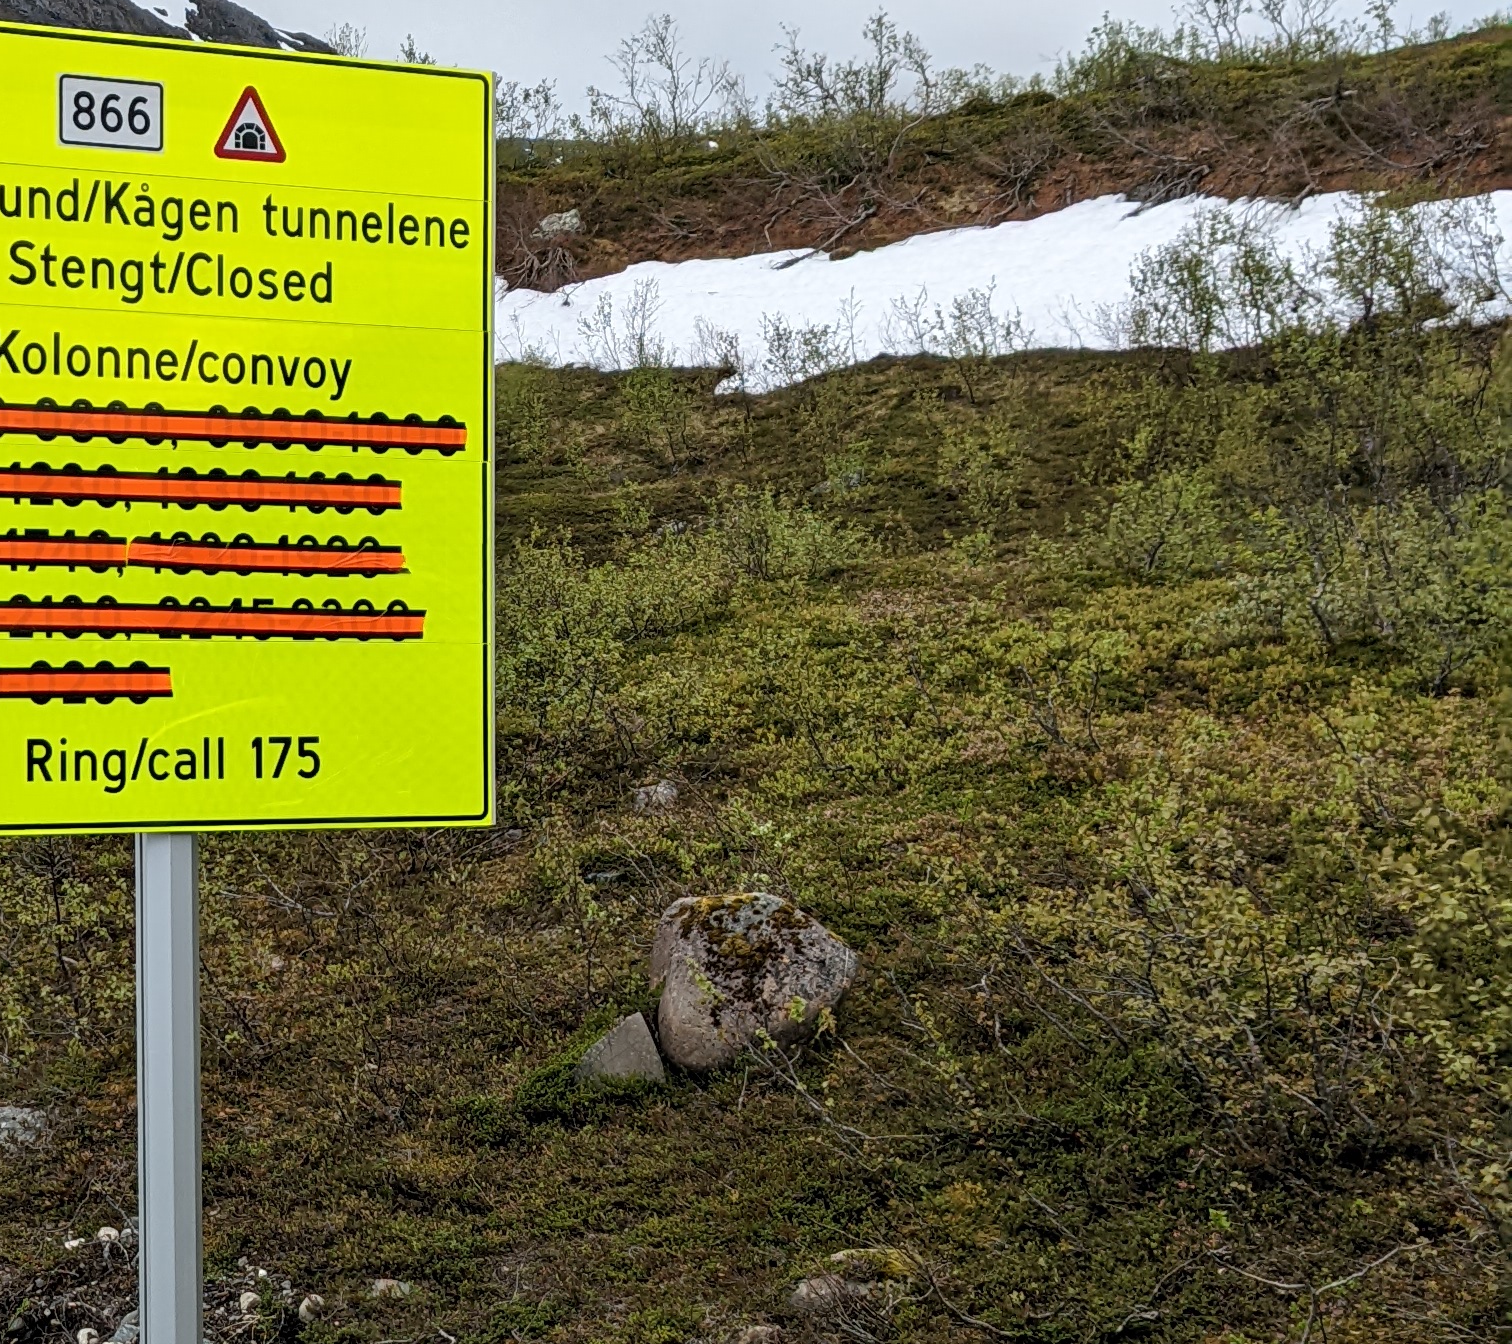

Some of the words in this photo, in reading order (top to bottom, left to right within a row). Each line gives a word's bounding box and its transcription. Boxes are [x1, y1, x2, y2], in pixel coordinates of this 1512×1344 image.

[72, 90, 151, 136] 866
[262, 195, 471, 249] tunnelene
[8, 240, 333, 304] Stengt/Closed
[26, 736, 226, 794] Ring/call
[251, 736, 321, 779] 175
